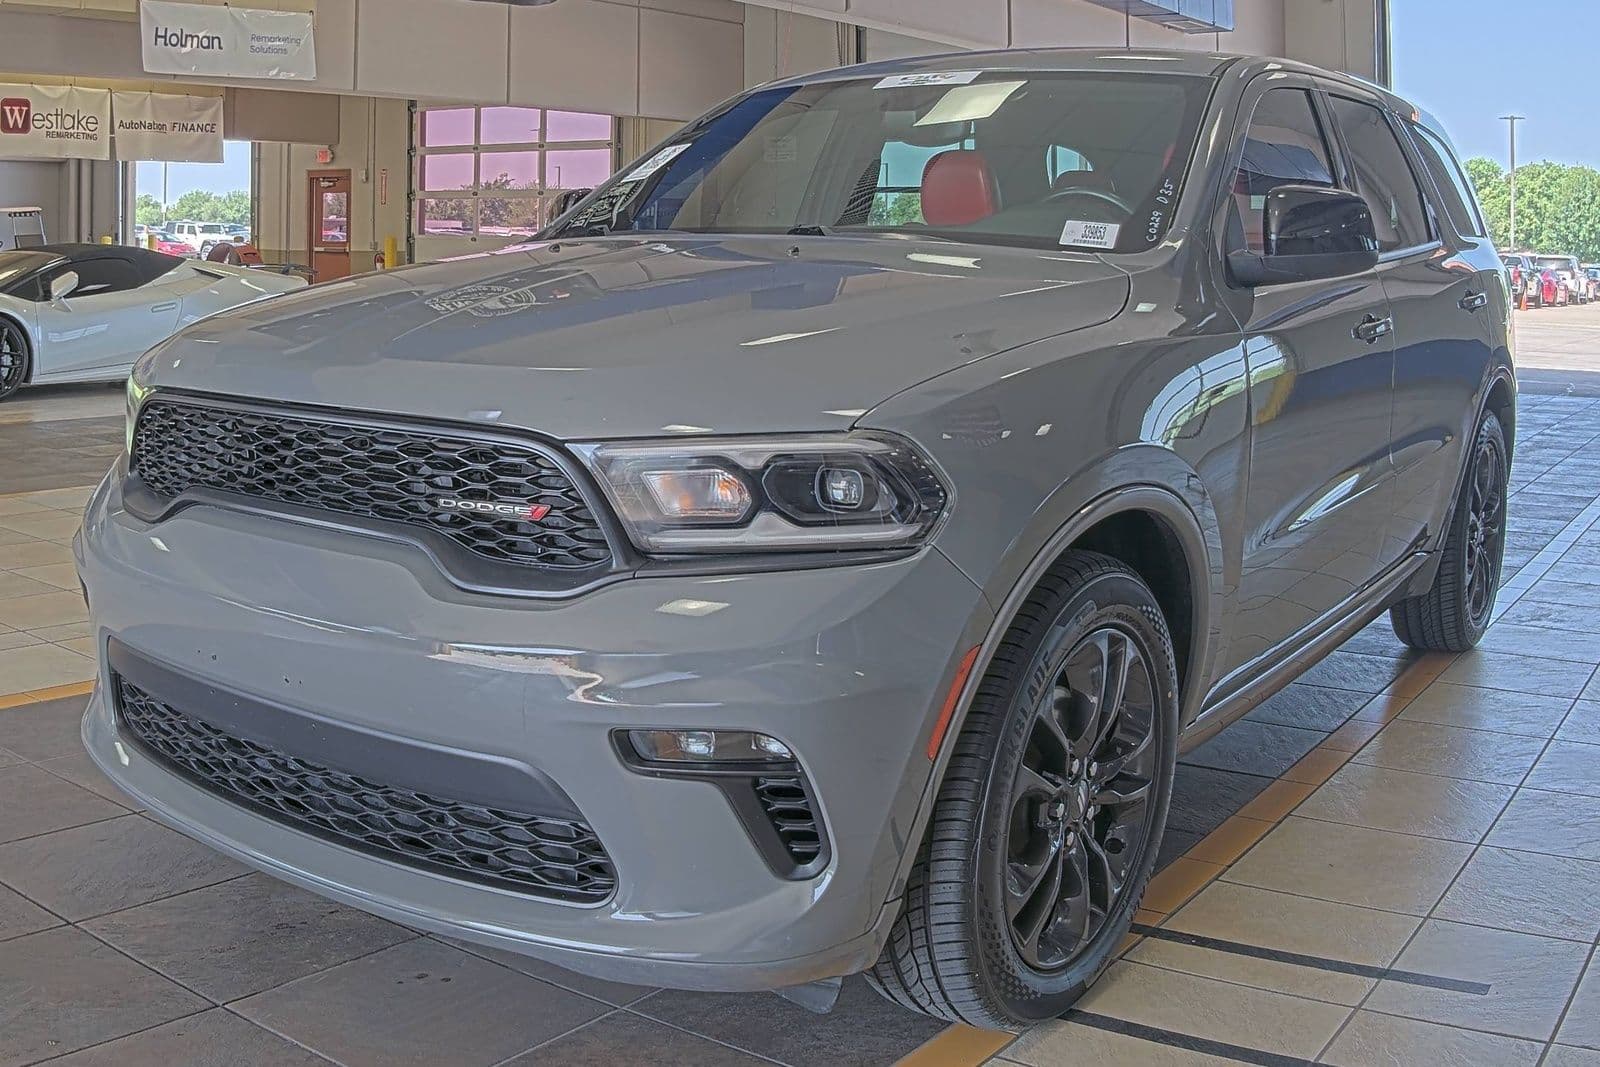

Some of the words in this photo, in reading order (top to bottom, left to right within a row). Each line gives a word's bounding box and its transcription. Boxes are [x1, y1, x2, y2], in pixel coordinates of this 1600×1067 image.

[154, 26, 223, 50] Holman
[251, 33, 301, 45] Remarketing
[250, 45, 288, 54] Solutions
[3, 105, 99, 132] Westlake
[118, 119, 167, 131] AutoNation
[172, 122, 216, 133] FINANCE
[45, 131, 98, 140] REMARKETING
[439, 499, 532, 516] DODGE
